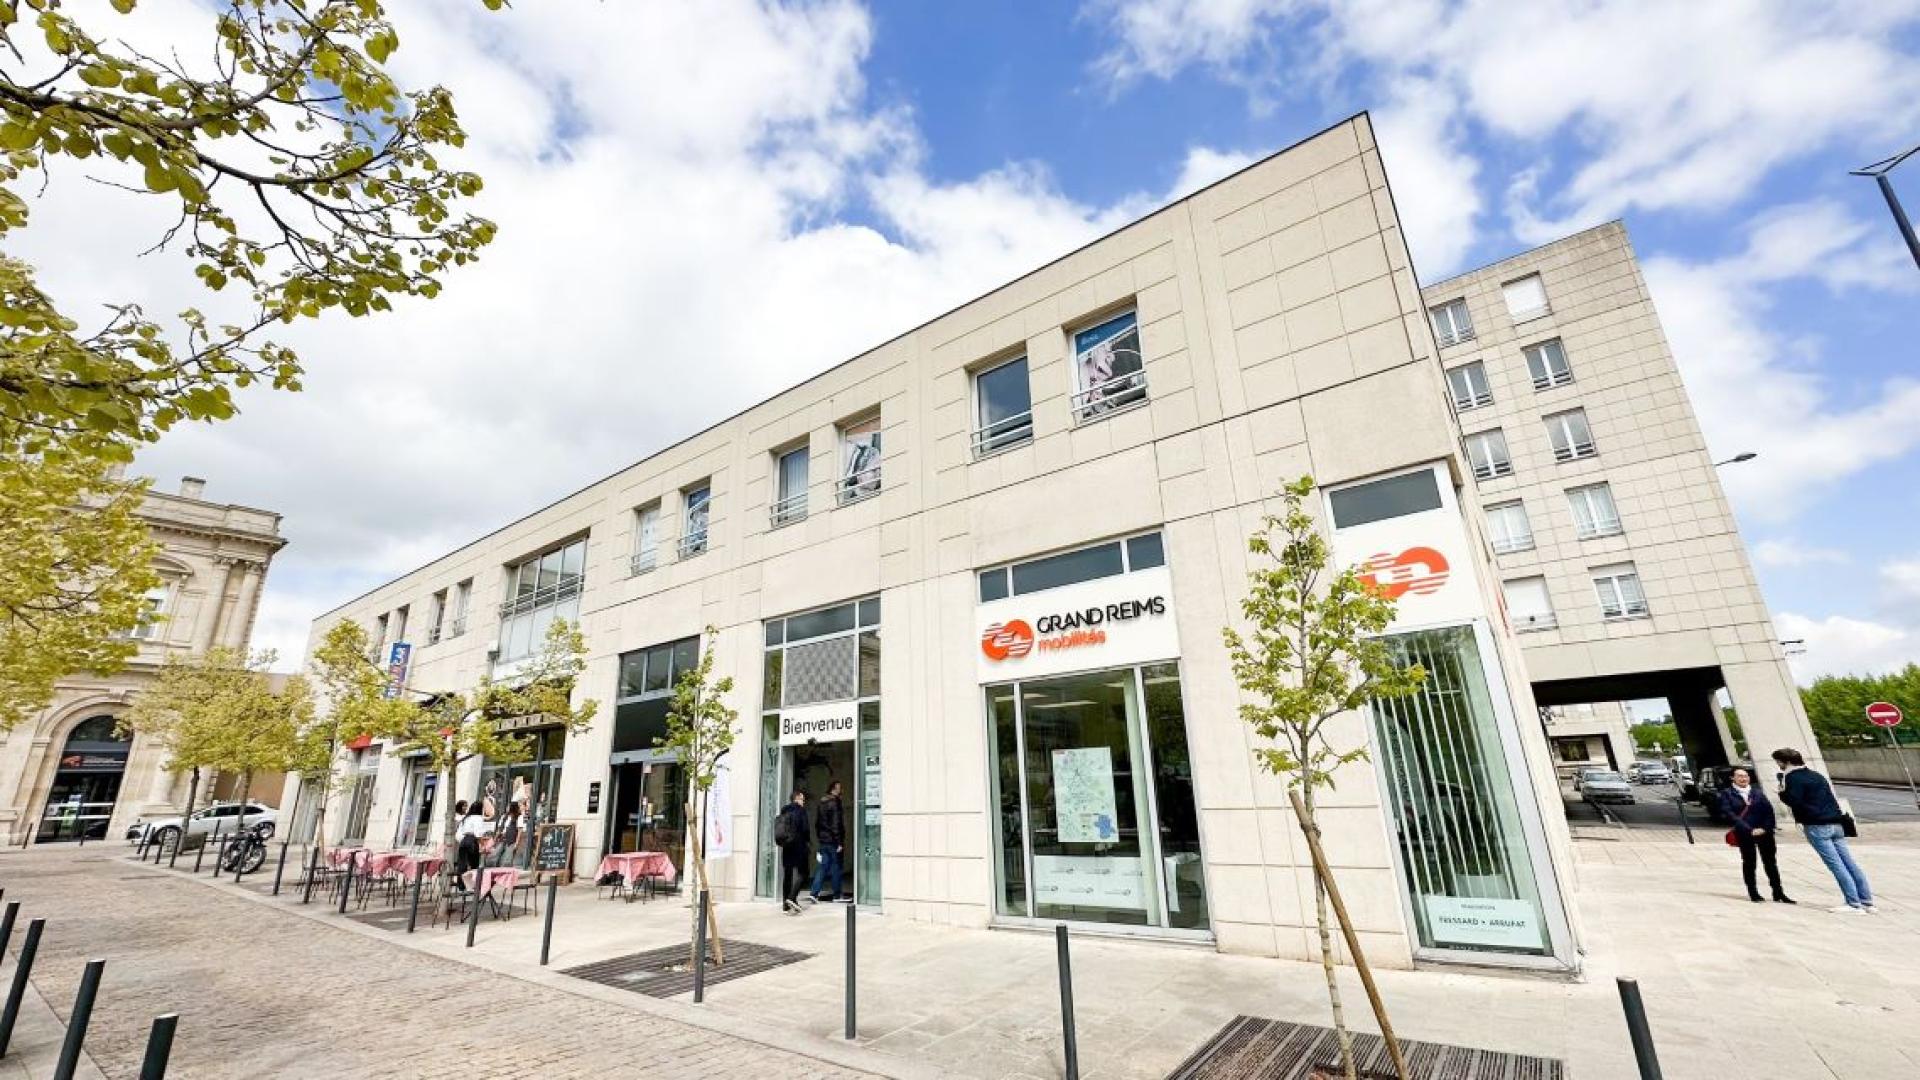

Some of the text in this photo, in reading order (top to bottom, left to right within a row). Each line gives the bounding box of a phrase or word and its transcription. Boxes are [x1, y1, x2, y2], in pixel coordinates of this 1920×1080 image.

[1037, 596, 1166, 634] GRAND REIMS
[1038, 628, 1106, 652] mobilités
[783, 716, 853, 735] Bienvenue
